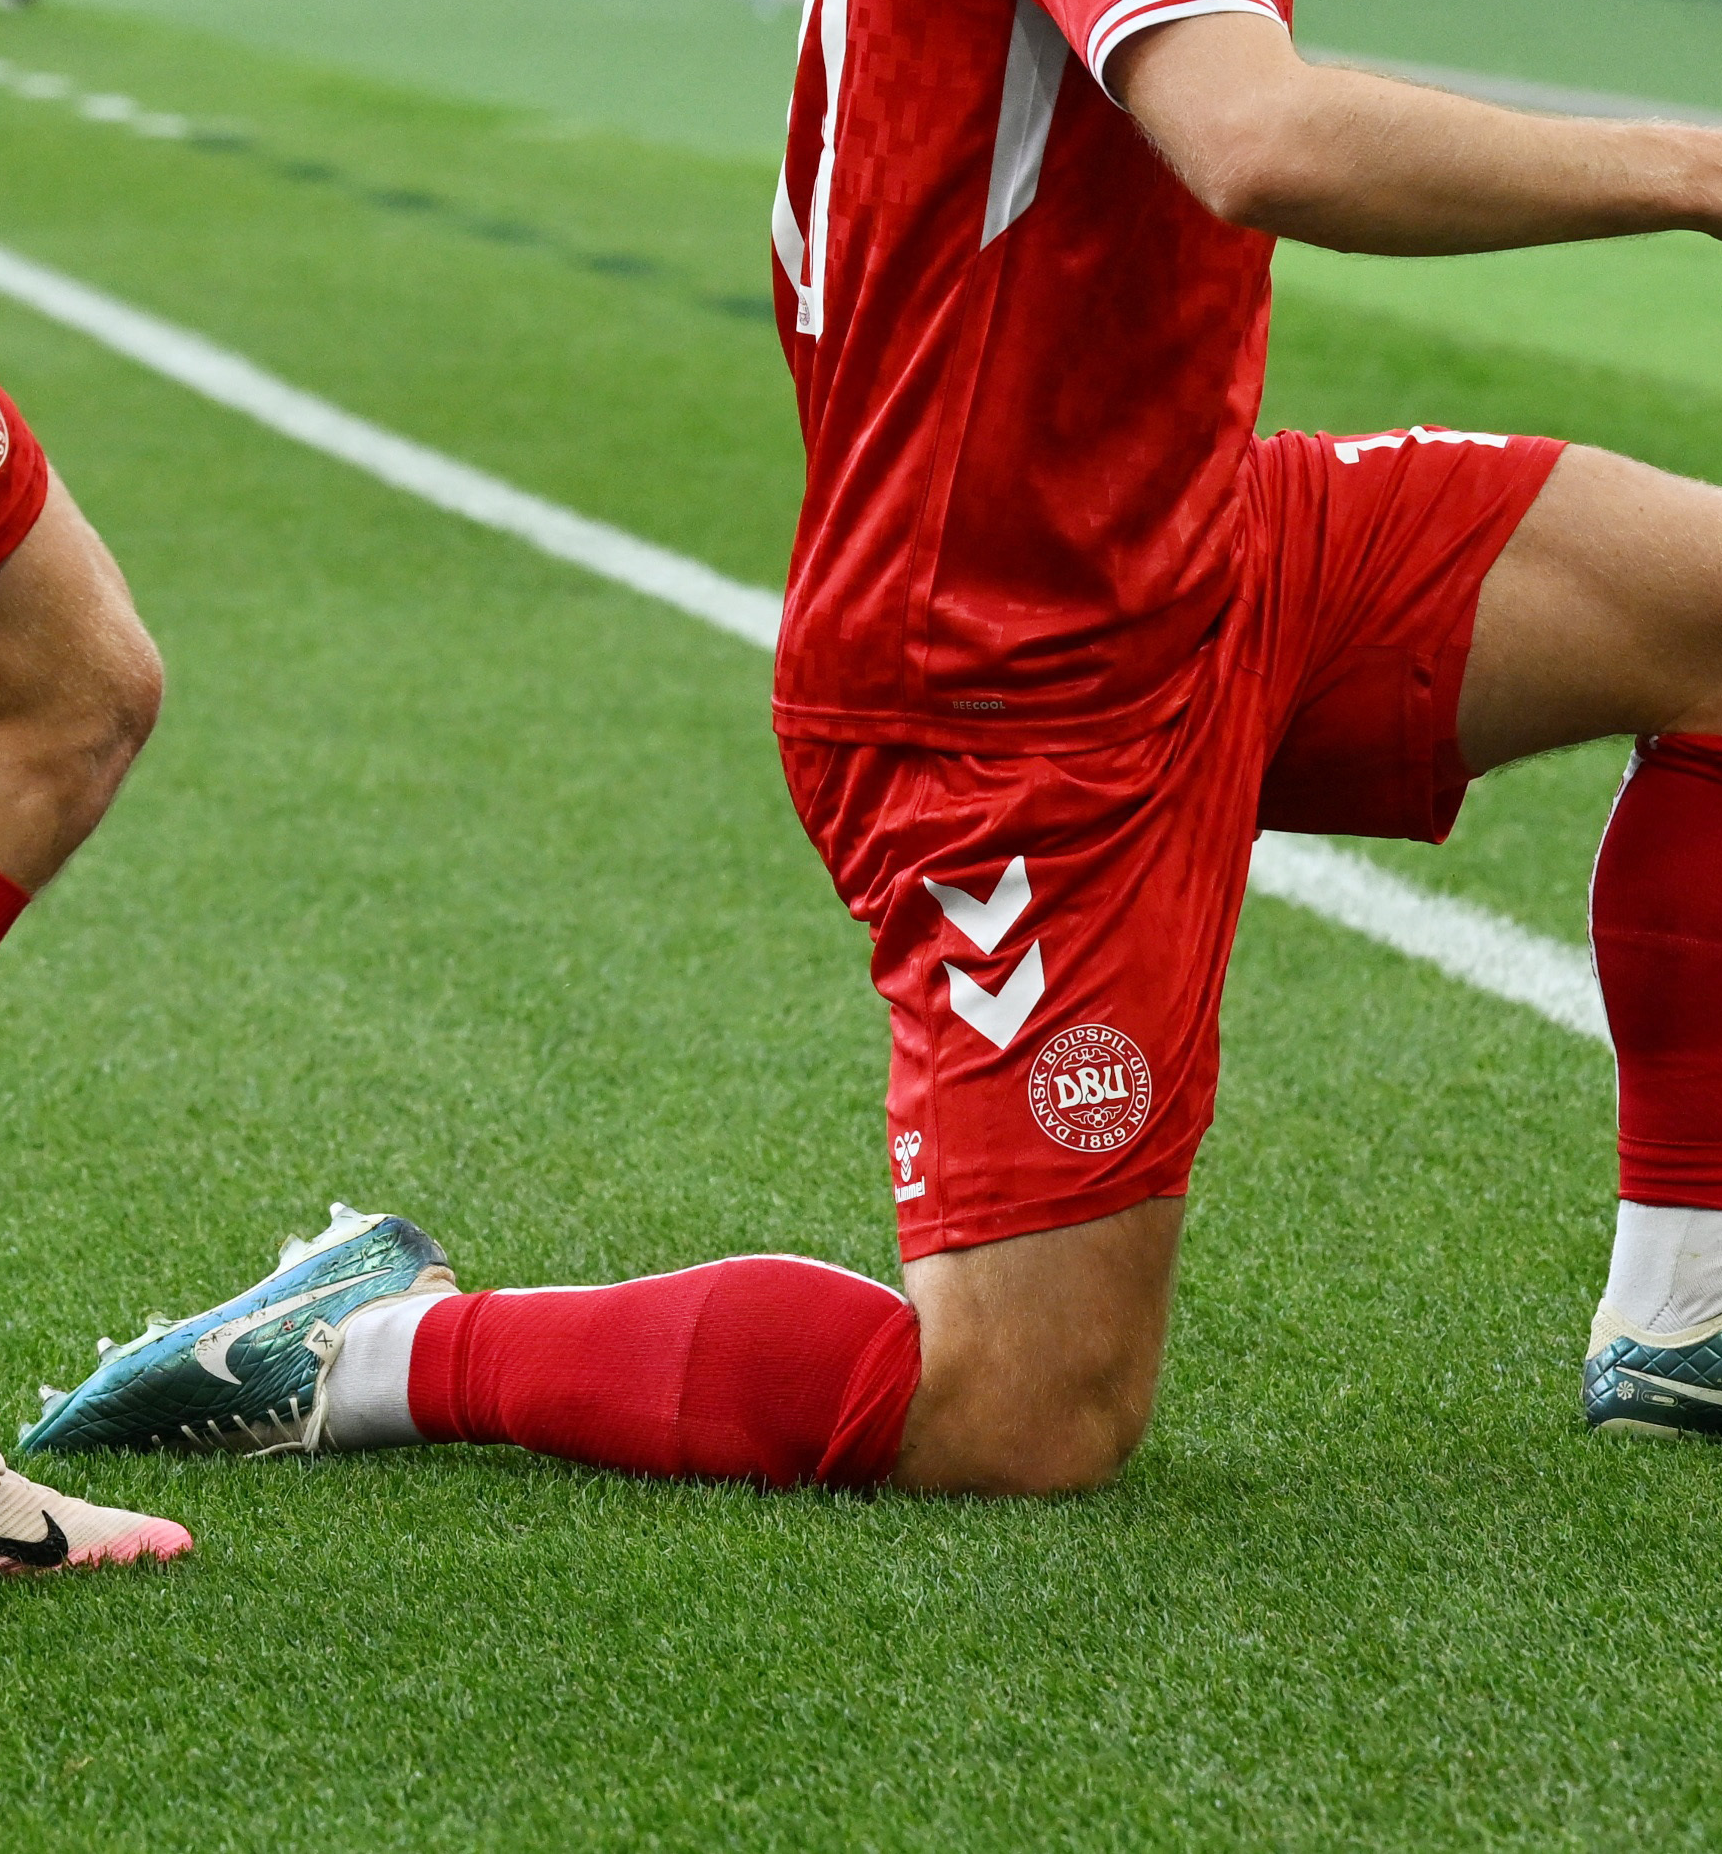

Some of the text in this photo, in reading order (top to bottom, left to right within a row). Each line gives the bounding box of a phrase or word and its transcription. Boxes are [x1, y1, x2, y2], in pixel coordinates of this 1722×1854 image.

[1053, 1064, 1129, 1109] DBU
[1033, 1071, 1071, 1140] DANSK
[1078, 1127, 1126, 1148] 1889
[895, 1176, 925, 1203] hummel
